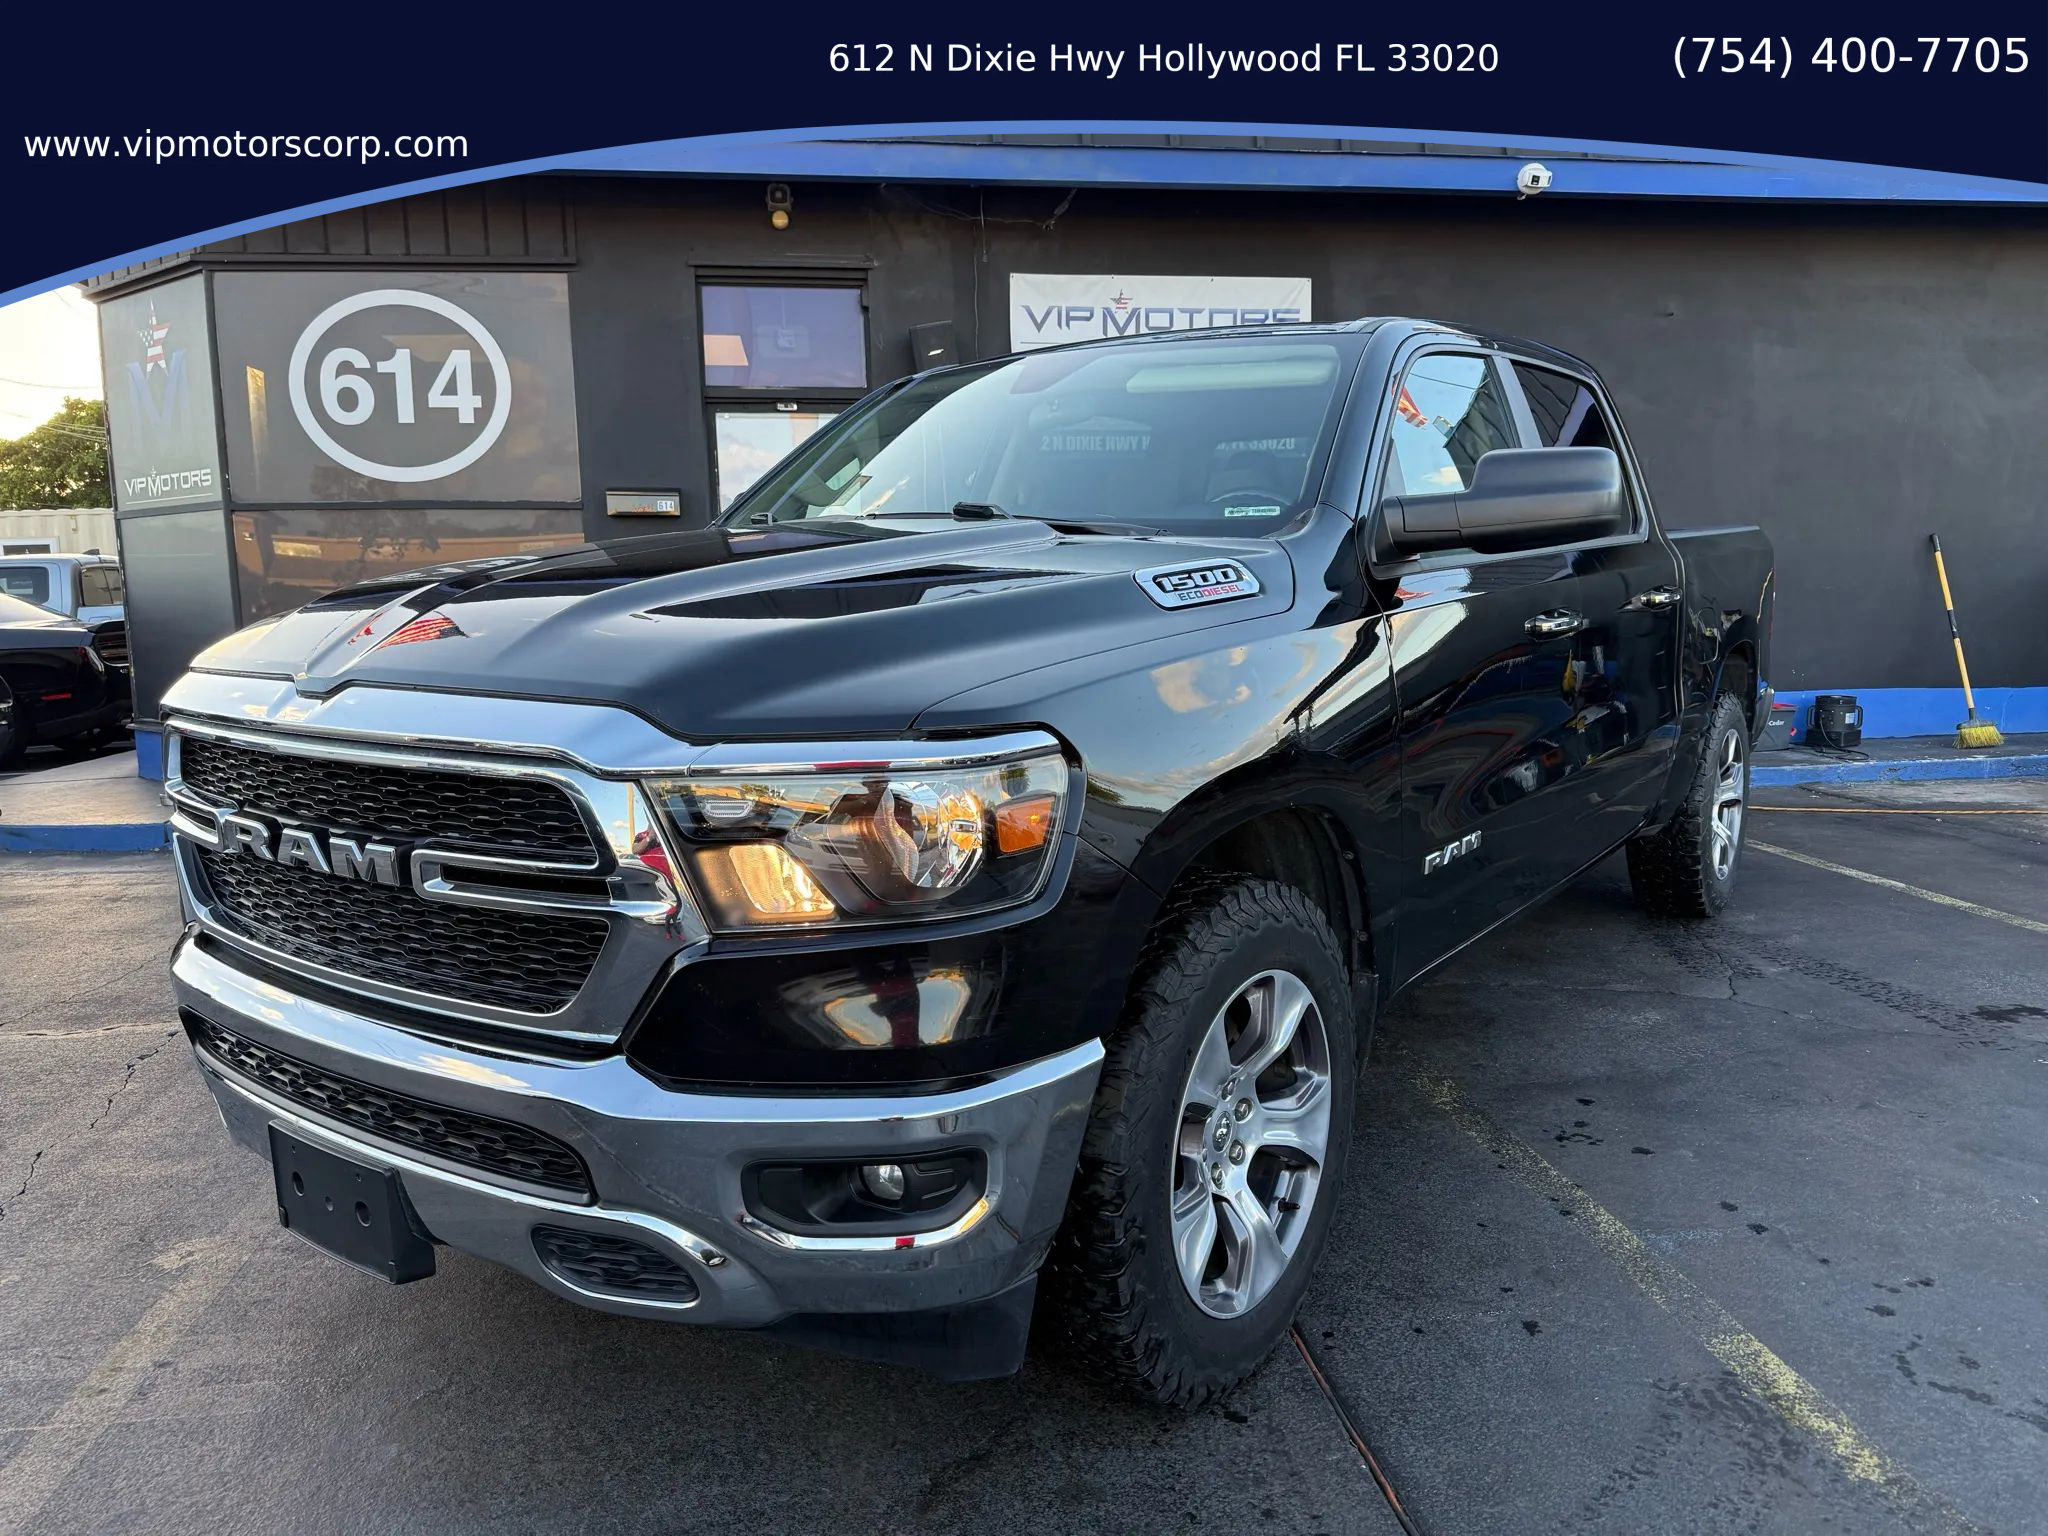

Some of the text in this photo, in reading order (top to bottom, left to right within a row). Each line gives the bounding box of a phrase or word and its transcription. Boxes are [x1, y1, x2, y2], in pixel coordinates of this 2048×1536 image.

[1021, 304, 1095, 333] VIP
[319, 346, 482, 425] 614
[1065, 435, 1103, 451] DIXIE
[123, 468, 212, 497] VIP MOTORS
[658, 501, 674, 511] 614
[1155, 567, 1239, 592] 1500
[1177, 584, 1245, 601] ECODIESEL
[223, 814, 400, 887] RAM
[1423, 829, 1482, 876] RAM
